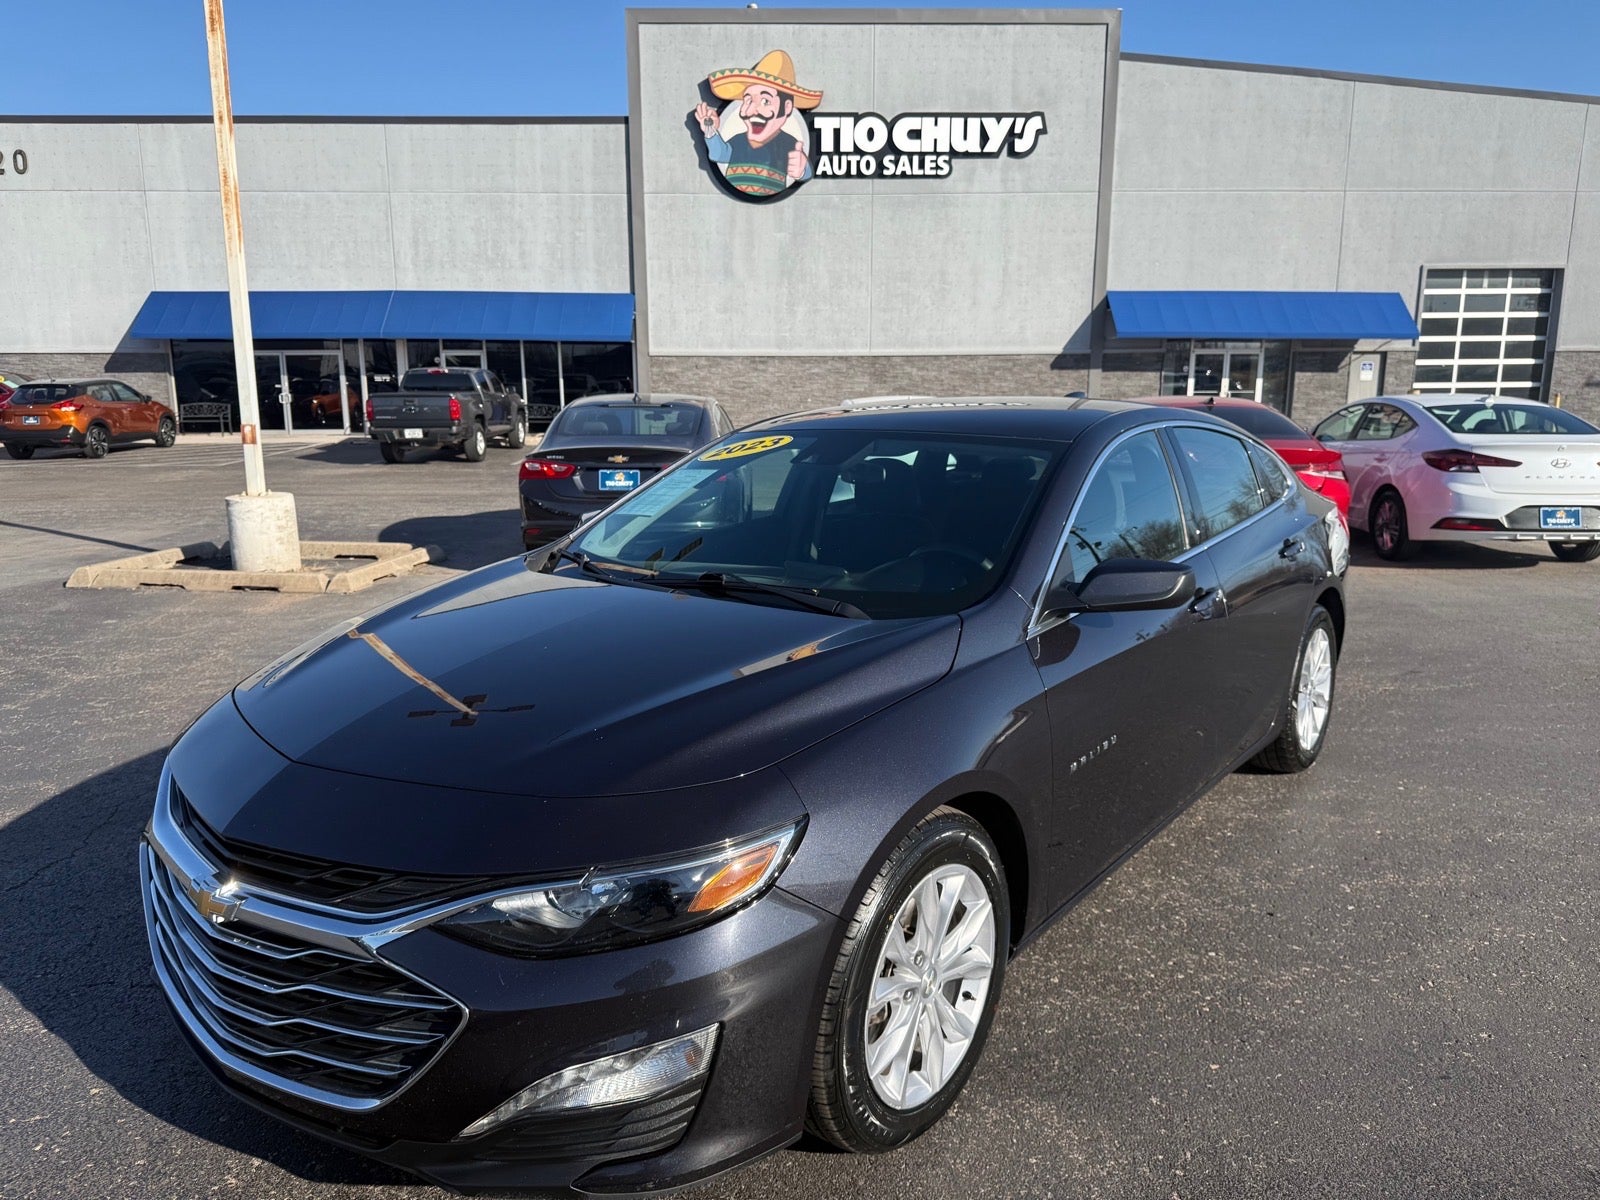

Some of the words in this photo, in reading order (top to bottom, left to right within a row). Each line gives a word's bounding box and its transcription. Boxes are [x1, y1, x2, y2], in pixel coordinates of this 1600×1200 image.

[814, 116, 888, 152] TIO
[892, 115, 1043, 152] CHUY'S
[815, 155, 877, 176] AUTO
[882, 155, 951, 176] SALES
[706, 437, 785, 459] 2023
